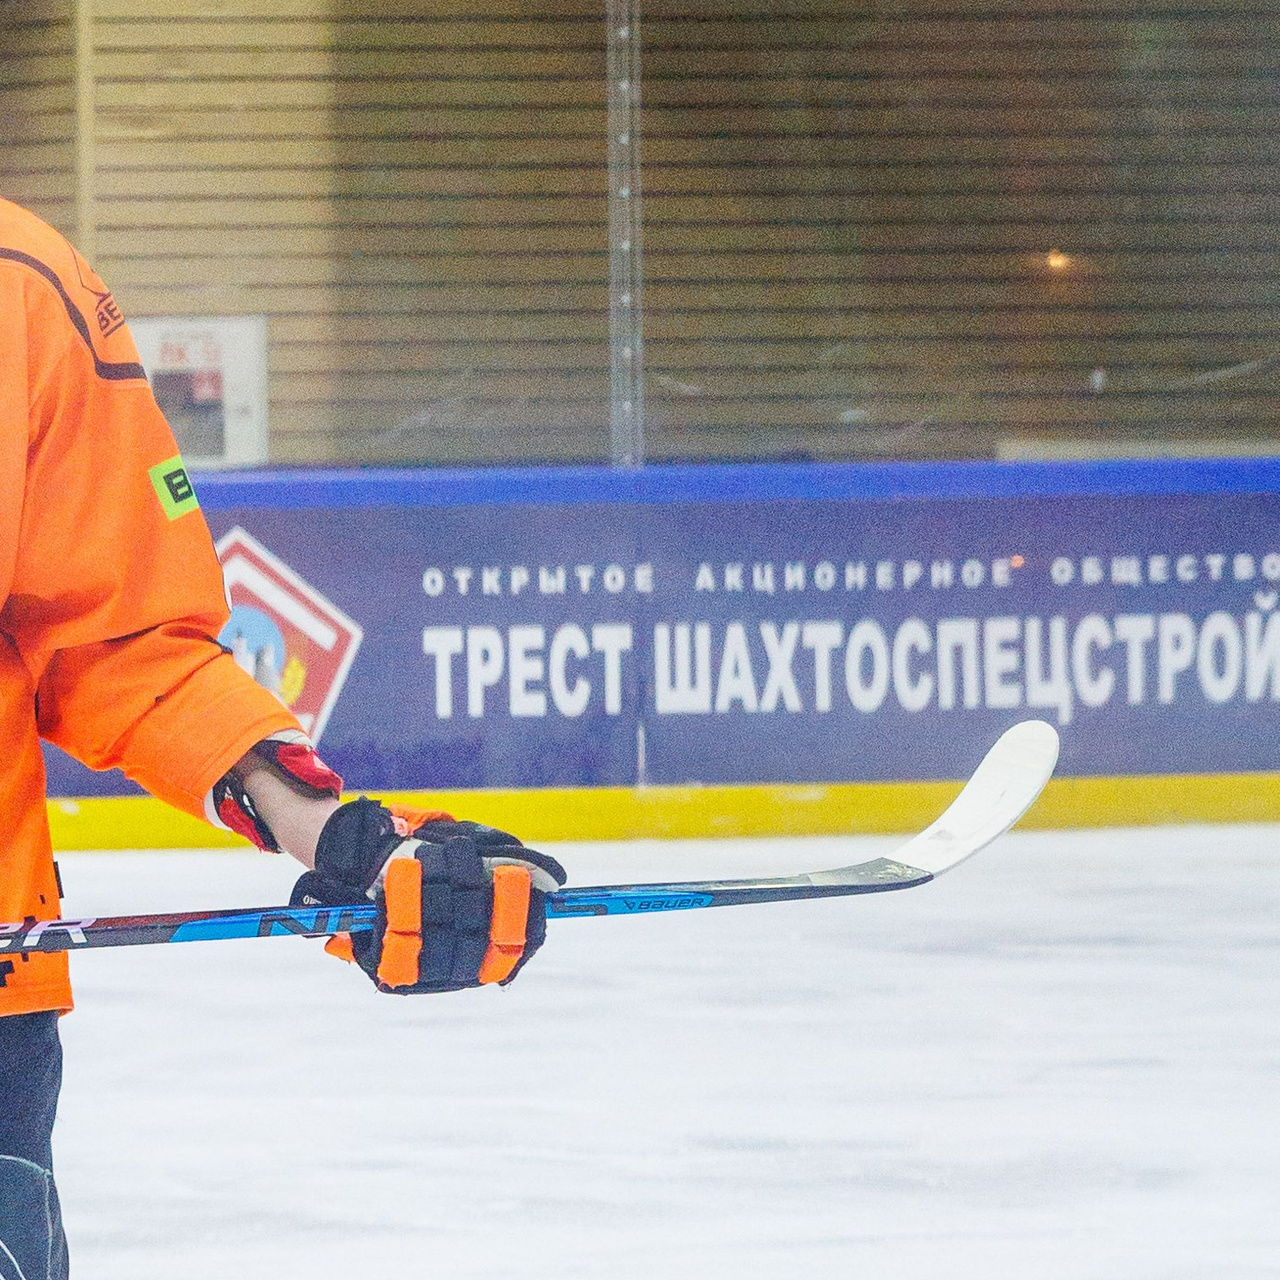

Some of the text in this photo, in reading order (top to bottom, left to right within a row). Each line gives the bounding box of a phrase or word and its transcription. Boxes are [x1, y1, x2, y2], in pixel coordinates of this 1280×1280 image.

[422, 565, 653, 596] ОТКРЫТОЕ
[695, 560, 1010, 594] АКЦИОНЕРНОЕ
[422, 590, 1280, 725] ТРЕСТ ШАХТОСПЕЦСТРОЙ
